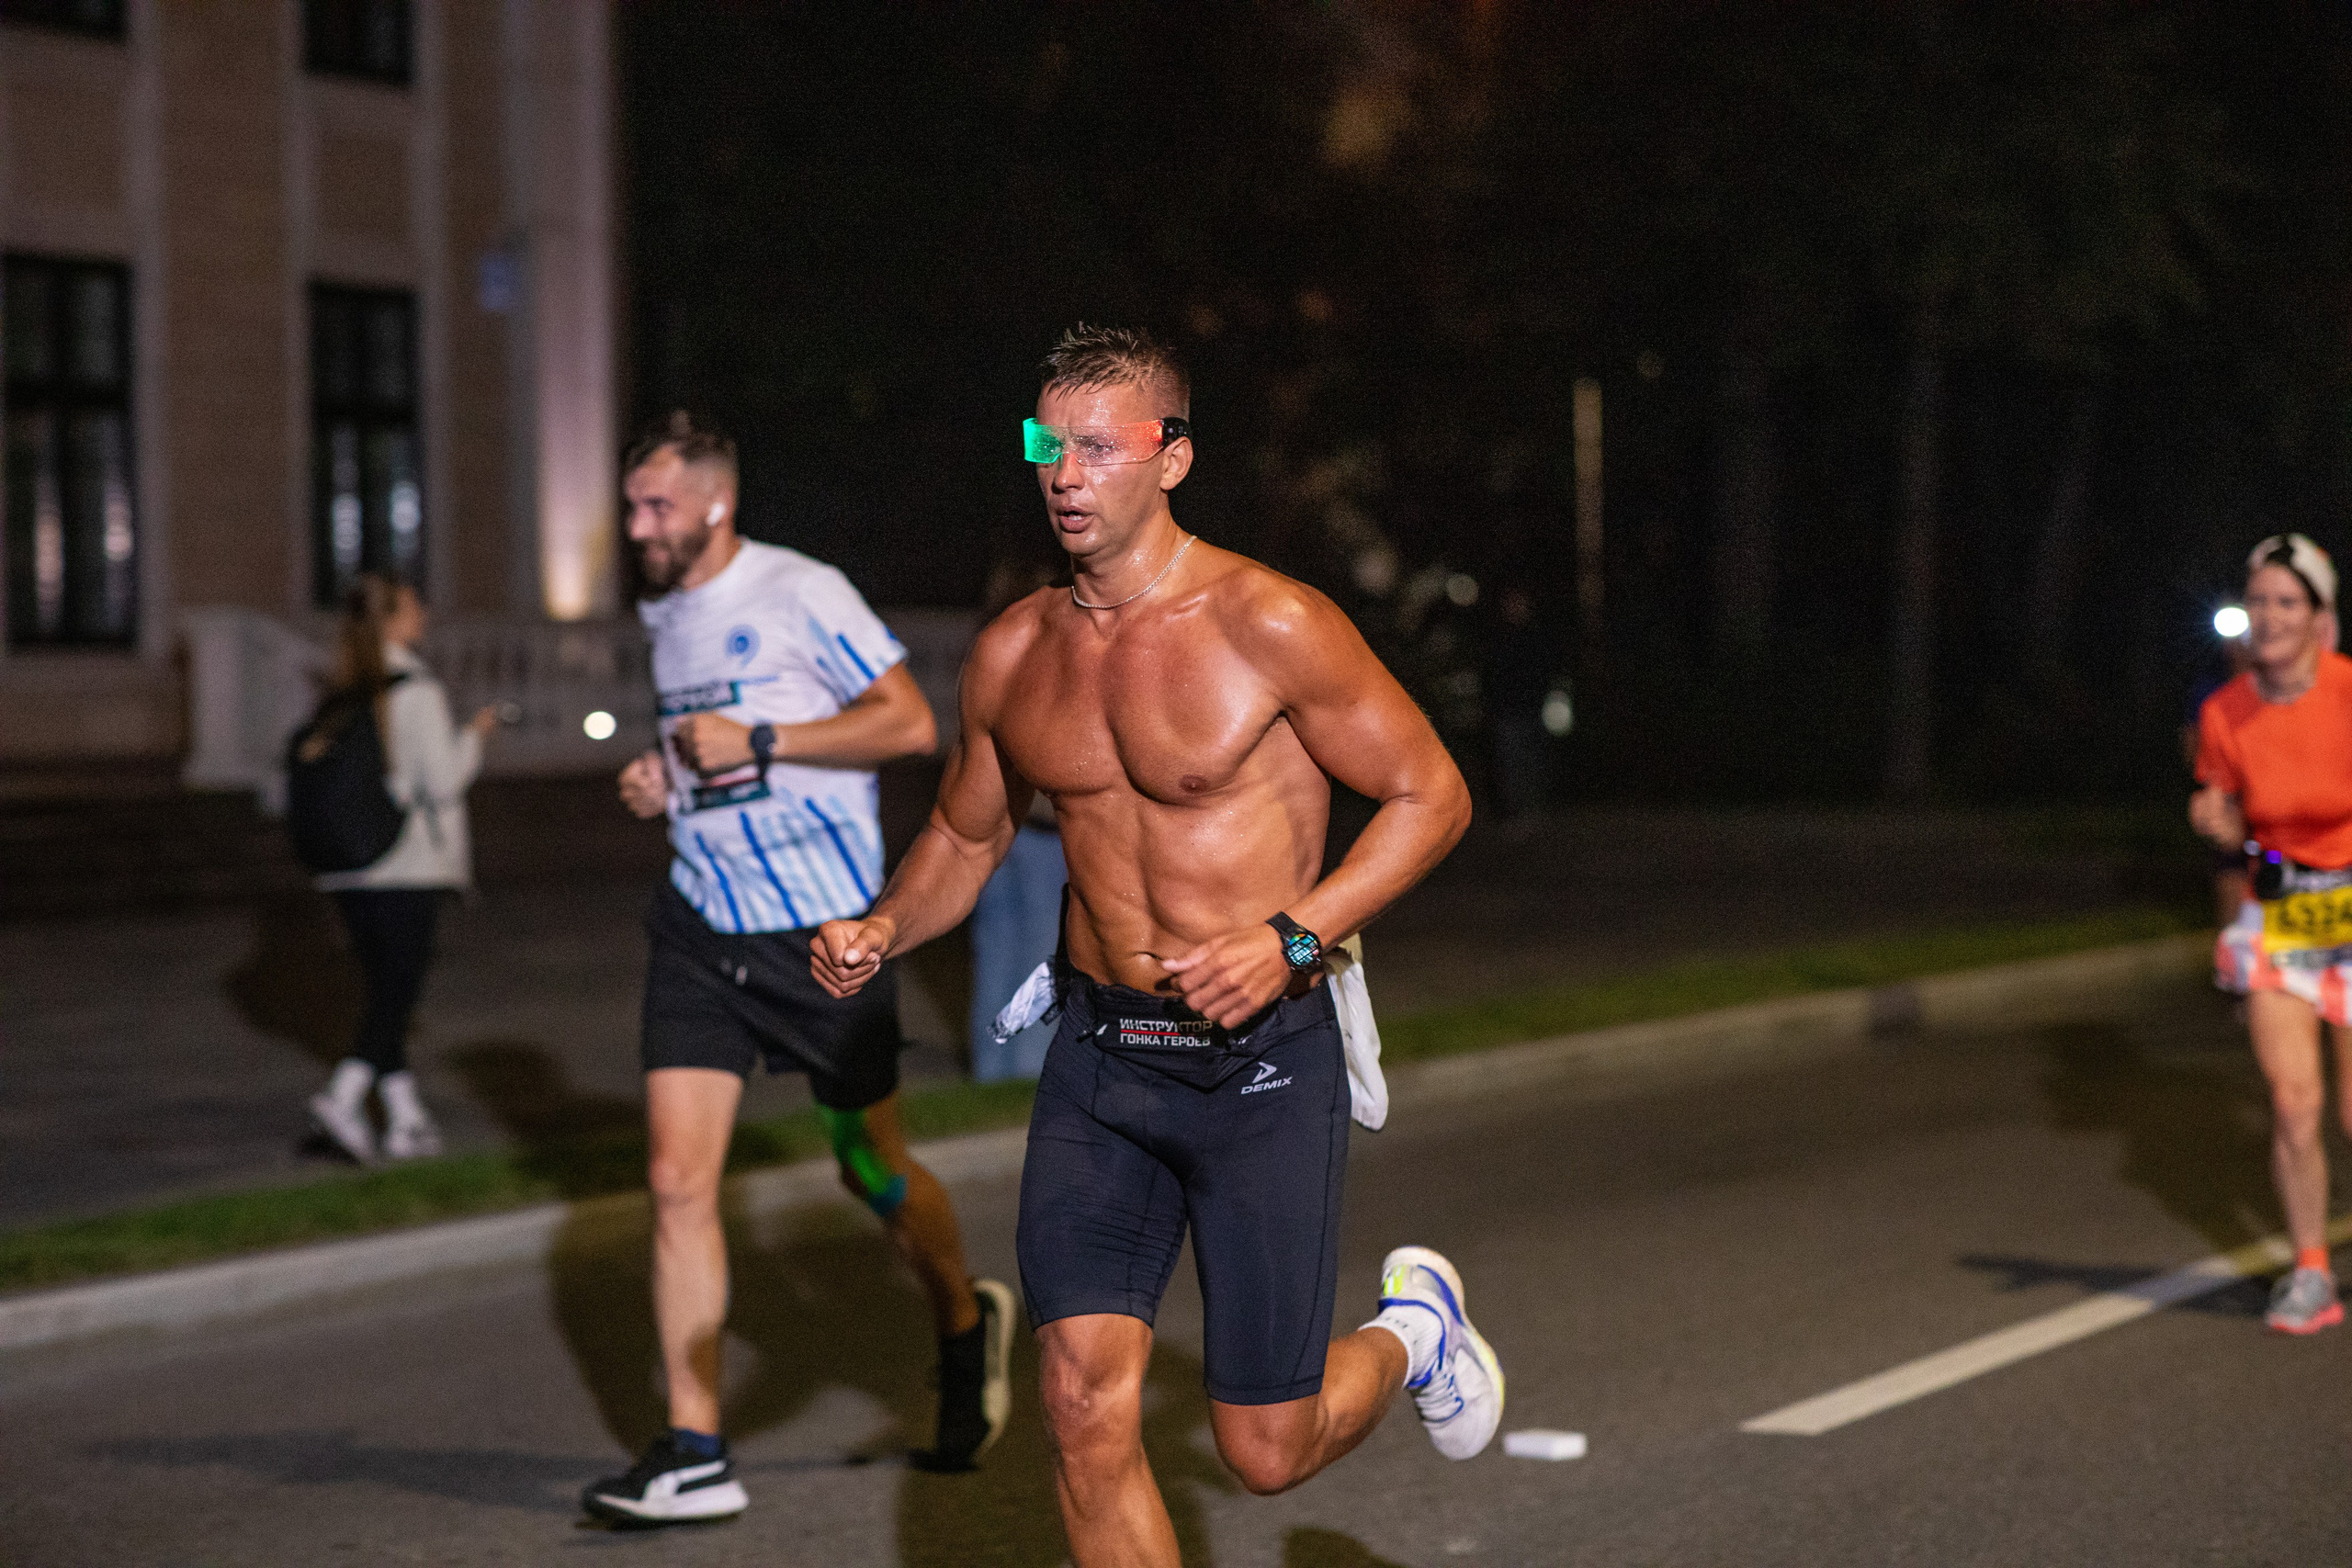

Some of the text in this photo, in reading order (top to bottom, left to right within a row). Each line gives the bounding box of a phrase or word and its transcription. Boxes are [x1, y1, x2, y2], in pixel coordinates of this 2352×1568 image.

[1119, 1018, 1213, 1032] ИНСТРУКТОР
[1120, 1033, 1211, 1047] ГОНКА ГЕРОЕВ
[1240, 1077, 1293, 1094] DEMIX
